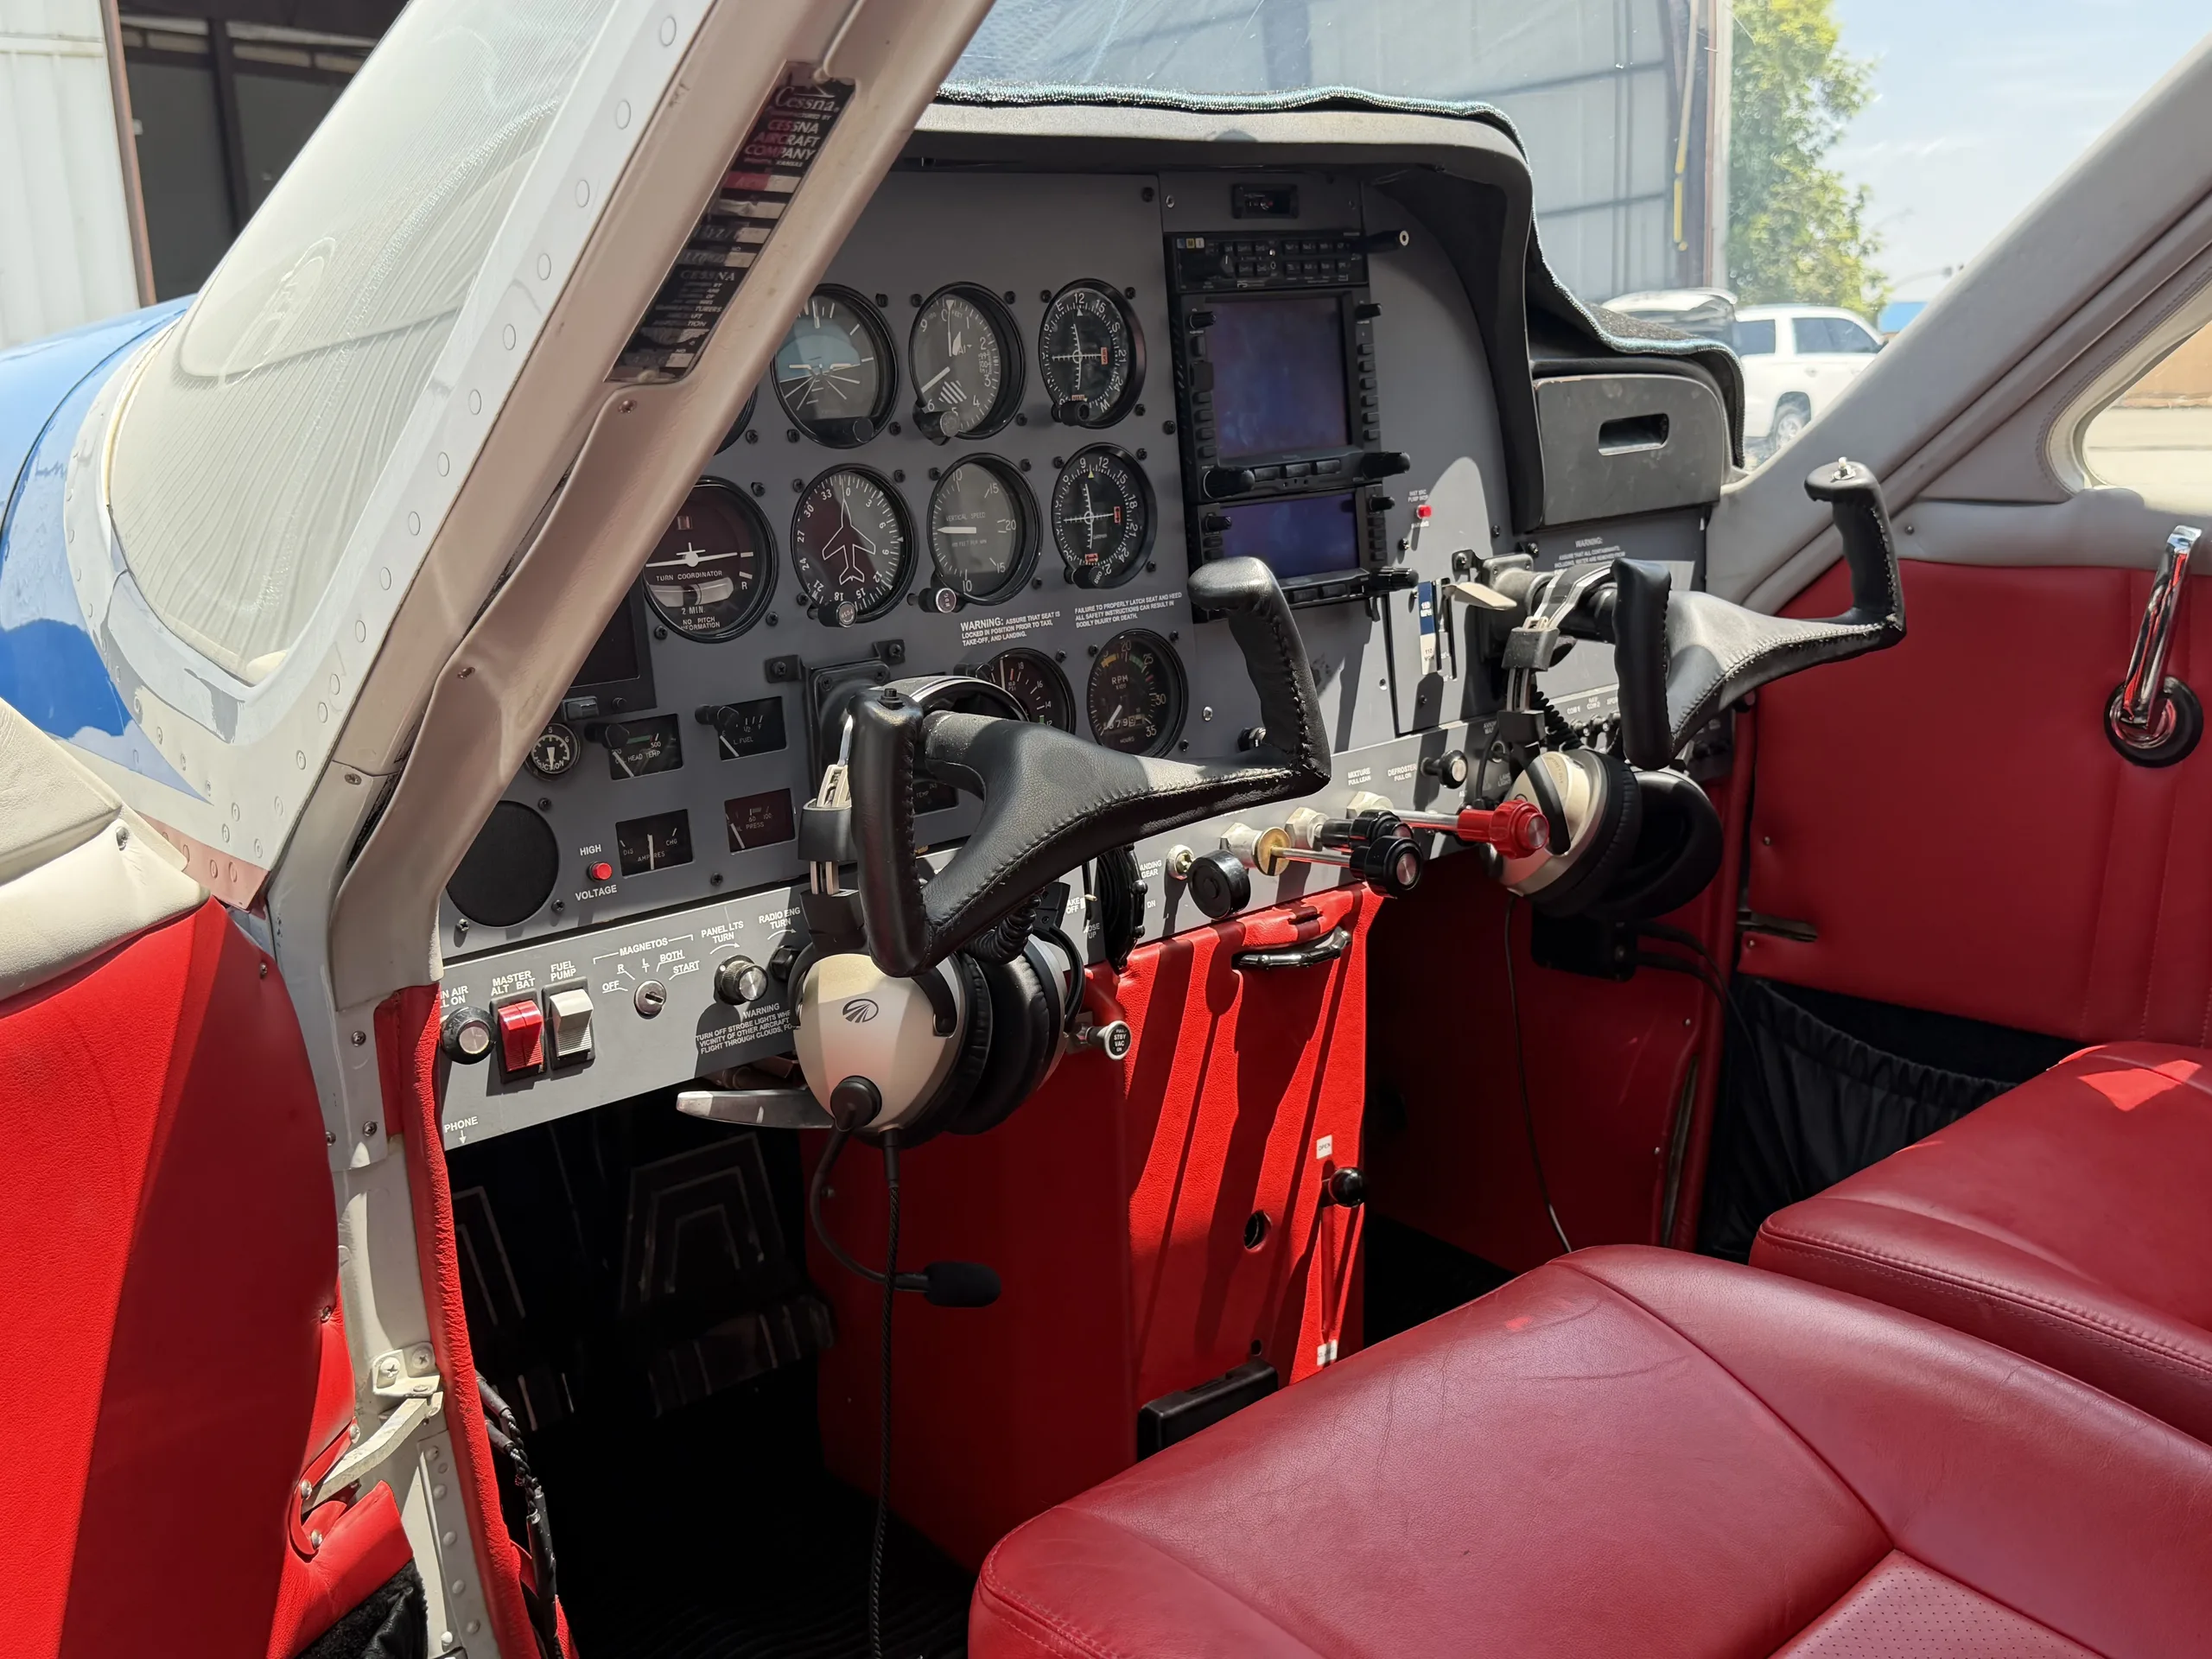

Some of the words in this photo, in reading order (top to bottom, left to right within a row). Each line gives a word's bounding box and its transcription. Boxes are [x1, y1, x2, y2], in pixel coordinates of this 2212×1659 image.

[775, 86, 836, 111] Cessna
[768, 119, 819, 134] CESSNA
[753, 132, 821, 148] AIRCRAFT
[745, 144, 816, 161] COMPANY
[1074, 293, 1085, 304] 12
[1055, 301, 1065, 312] E
[1095, 299, 1106, 313] 15
[920, 319, 928, 333] 9
[1112, 321, 1121, 333] S
[980, 337, 987, 351] 2
[1118, 349, 1128, 364] 21
[984, 374, 992, 387] 3
[1114, 376, 1124, 392] 24
[927, 399, 935, 412] 6
[973, 395, 981, 408] 4
[1100, 398, 1110, 413] W
[1080, 457, 1086, 468] 9
[1099, 456, 1109, 469] 12
[952, 469, 963, 482] 10
[1117, 469, 1128, 485] 15
[821, 489, 832, 500] 33
[845, 487, 851, 497] 0
[989, 483, 1000, 494] 15
[865, 499, 873, 508] 3
[1128, 494, 1138, 510] 18
[804, 505, 815, 518] 30
[1005, 519, 1017, 531] 20
[1129, 524, 1139, 537] 21
[797, 530, 805, 543] 27
[1119, 546, 1130, 563] 24
[799, 557, 810, 571] 24
[995, 563, 1006, 574] 15
[677, 570, 723, 581] COORDINATOR
[872, 570, 883, 583] 12
[741, 581, 748, 591] R
[962, 580, 973, 593] 10
[834, 591, 844, 601] 18
[855, 588, 867, 600] 15
[1074, 605, 1096, 614] FAILURE
[1103, 600, 1129, 610] PROPERLY
[1129, 597, 1146, 606] LATCH
[1085, 612, 1104, 620] SAFETY
[1104, 606, 1140, 617] INSTRUCTIONS
[960, 617, 1004, 632] WARNING:
[1006, 616, 1027, 625] ASSURE
[1027, 613, 1040, 622] THAT
[1076, 620, 1094, 629] BODILY
[1094, 616, 1113, 626] INJURY
[961, 630, 983, 639] LOCKED
[991, 626, 1015, 635] POSITION
[962, 637, 990, 647] TAKE-OFF,
[1121, 639, 1132, 652] 20
[1018, 661, 1025, 670] 18
[1142, 653, 1154, 665] 25
[1111, 675, 1128, 685] RPM
[1045, 700, 1052, 709] 14
[1154, 693, 1166, 706] 30
[1145, 725, 1157, 738] 35
[627, 753, 643, 762] HEAD
[645, 750, 661, 759] TEMP
[1347, 767, 1371, 779] MIXTURE
[746, 821, 765, 830] PRESS
[665, 838, 678, 847] CHG
[580, 843, 602, 856] HIGH
[623, 848, 634, 856] DIS
[1141, 868, 1159, 879] GEAR
[575, 884, 618, 901] VOLTAGE
[1066, 897, 1080, 907] AKE
[1147, 899, 1156, 909] DN
[758, 909, 784, 925] RADIO
[784, 906, 801, 918] ENG
[1065, 905, 1079, 914] OFF
[701, 925, 728, 938] PANEL
[728, 920, 744, 931] LTS
[769, 917, 791, 930] TURN
[712, 931, 734, 944] TURN
[1088, 931, 1096, 939] UP
[619, 937, 669, 957] MAGNETOS
[642, 957, 649, 966] L
[659, 949, 683, 963] BOTH
[550, 960, 575, 973] FUEL
[617, 963, 625, 972] R
[672, 960, 701, 974] START
[492, 969, 532, 987] MASTER
[550, 968, 577, 982] PUMP
[451, 985, 469, 998] AIR
[491, 984, 510, 996] ALT
[516, 977, 536, 990] BAT
[601, 980, 620, 992] OFF
[450, 995, 466, 1006] ON
[742, 1002, 780, 1020] WARNING
[695, 1032, 714, 1042] TURN
[714, 1027, 728, 1037] OFF
[728, 1020, 753, 1033] STROBE
[754, 1014, 777, 1027] LIGHTS
[699, 1035, 726, 1048] VICINITY
[736, 1026, 759, 1038] OTHER
[760, 1017, 790, 1033] AIRCRAFT
[700, 1041, 724, 1055] FLIGHT
[724, 1033, 756, 1048] THROUGH
[756, 1027, 784, 1039] CLOUDS,
[443, 1116, 479, 1134] PHONE
